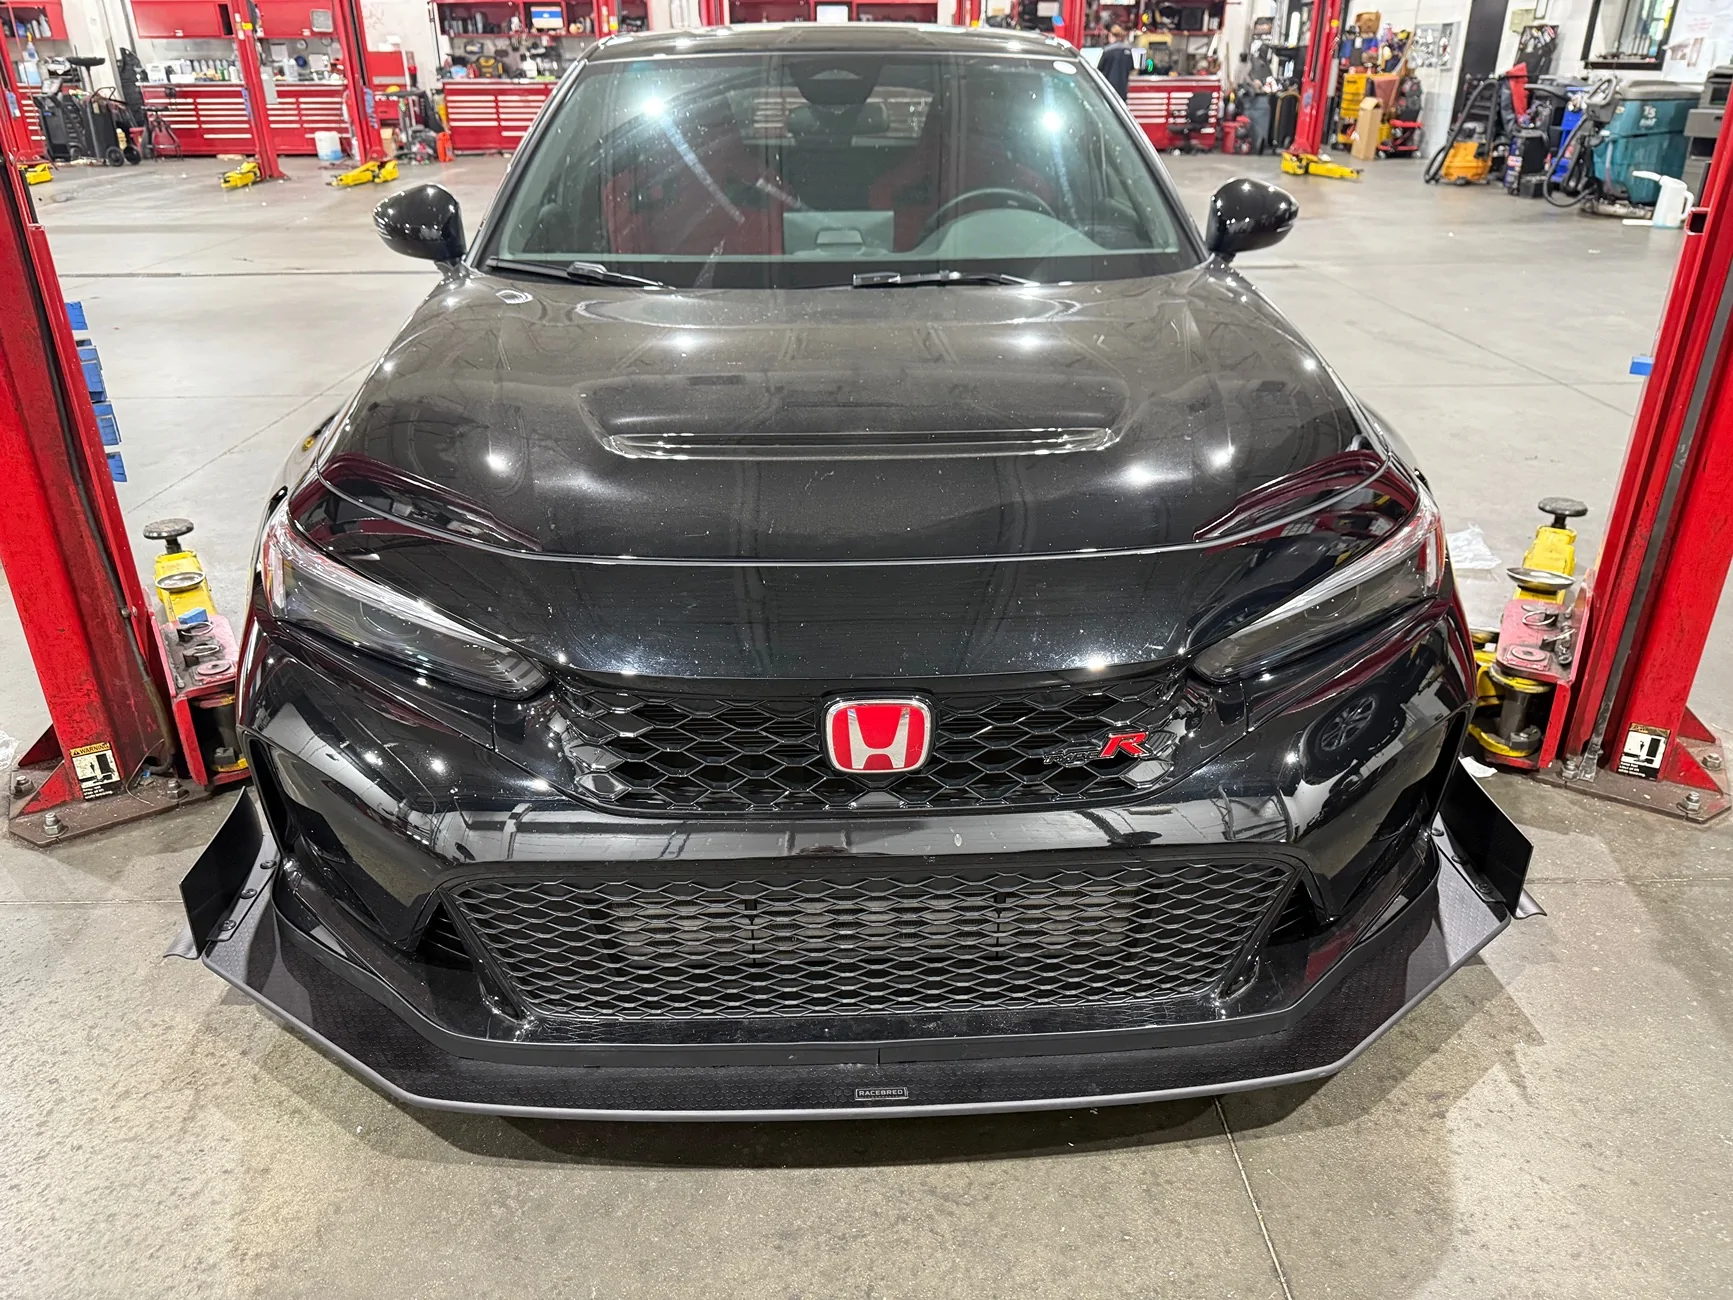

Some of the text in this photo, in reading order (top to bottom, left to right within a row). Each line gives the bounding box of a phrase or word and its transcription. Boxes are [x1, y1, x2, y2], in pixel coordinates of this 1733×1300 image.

[79, 743, 110, 754] WARNING
[846, 707, 911, 770] H
[1099, 731, 1153, 759] R
